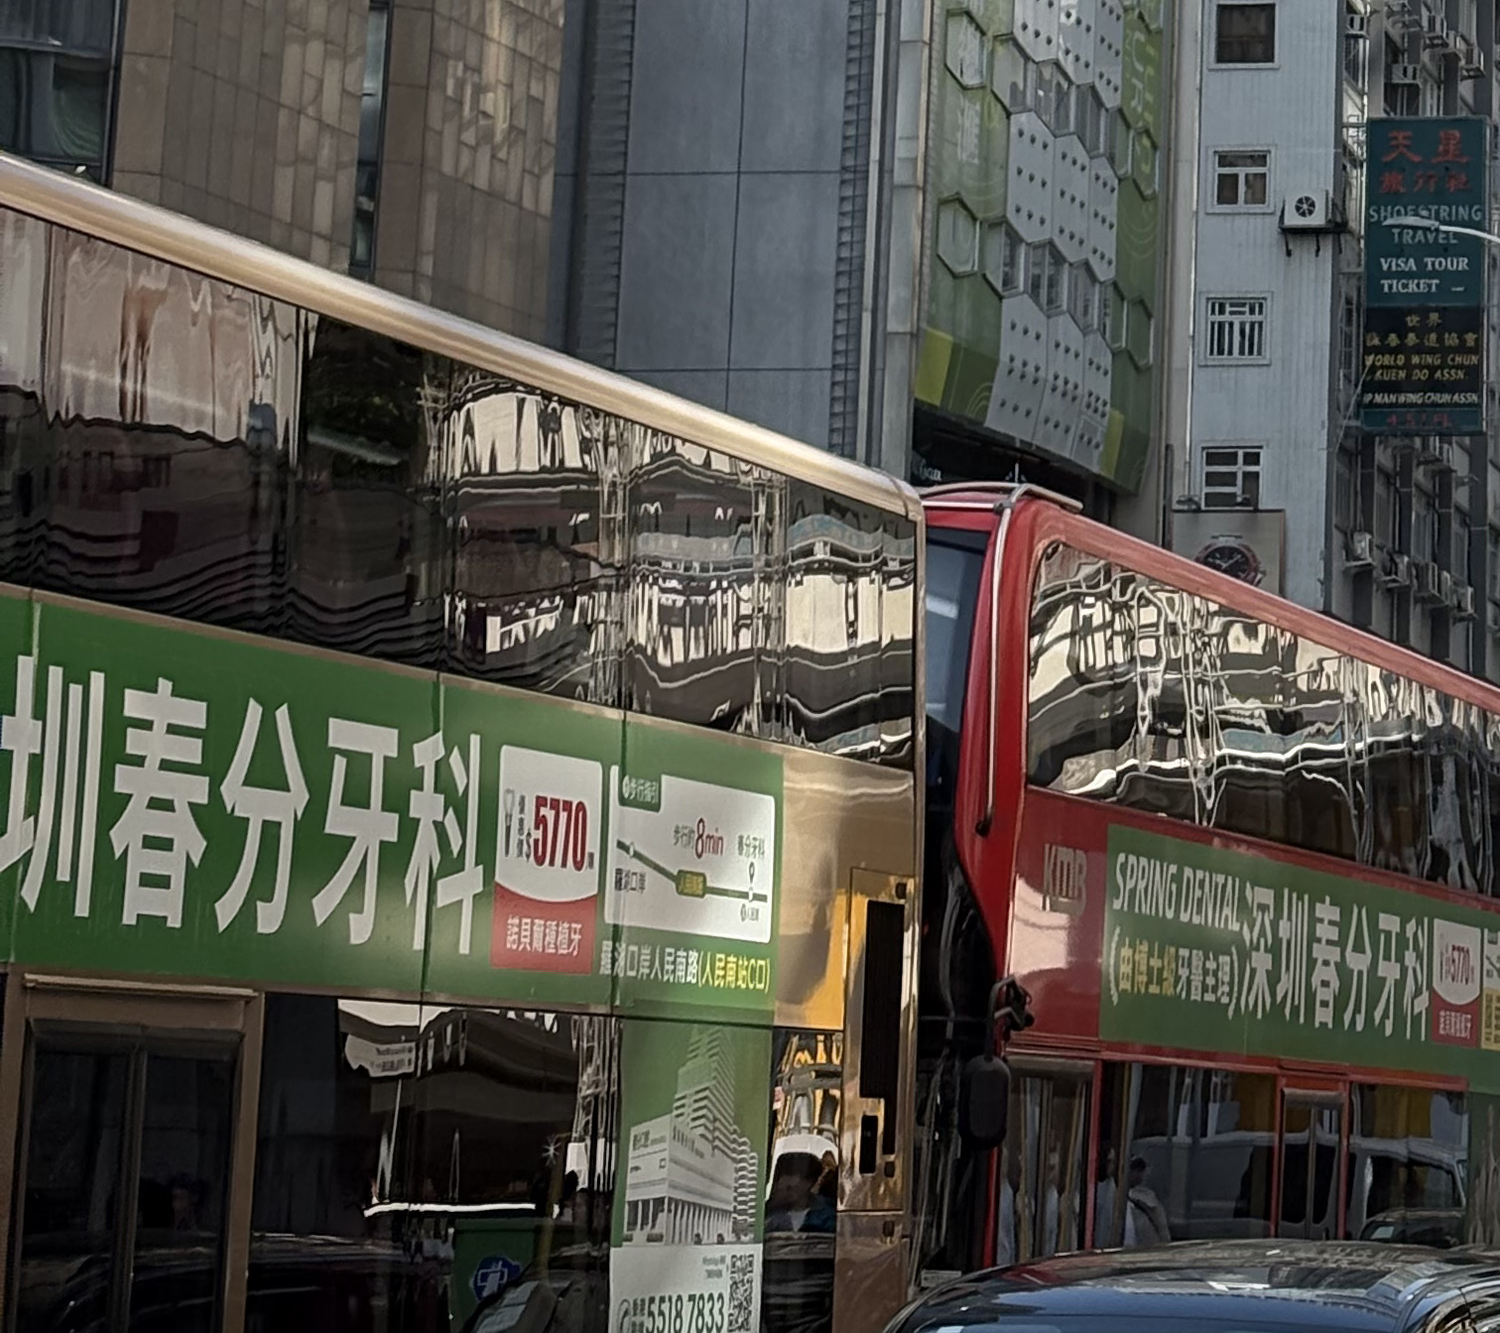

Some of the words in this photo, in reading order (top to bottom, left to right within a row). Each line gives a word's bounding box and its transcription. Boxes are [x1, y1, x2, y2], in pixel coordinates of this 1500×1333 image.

[1381, 130, 1471, 163] 天星
[1392, 226, 1459, 244] TRAVEL
[1380, 257, 1417, 271] VISA
[1424, 257, 1470, 271] TOUR
[1381, 279, 1440, 293] TICKET
[1364, 354, 1405, 365] WORLD
[1411, 354, 1441, 365] WING
[1447, 354, 1479, 365] CHUN
[1411, 369, 1429, 381] DO
[0, 656, 484, 955] 圳春分牙科
[1113, 852, 1178, 919] SPRING
[1179, 866, 1240, 931] DENTAL
[1240, 881, 1429, 1042] 深圳春分牙科
